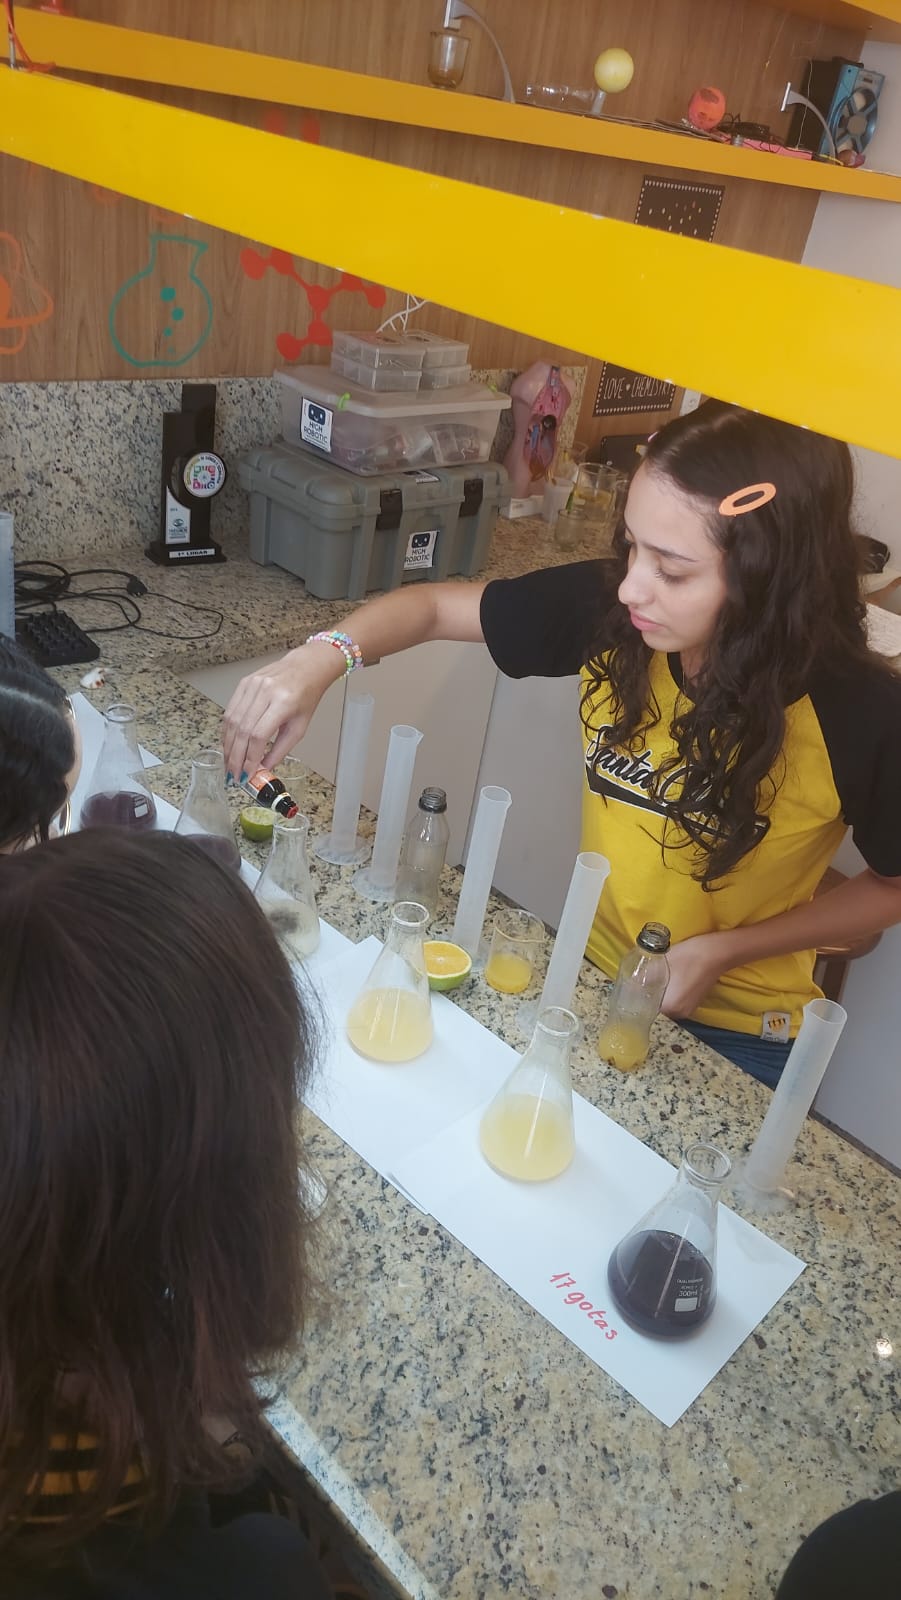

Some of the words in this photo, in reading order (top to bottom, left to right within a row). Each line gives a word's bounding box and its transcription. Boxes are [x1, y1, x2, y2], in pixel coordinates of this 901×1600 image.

[603, 377, 626, 399] LOVE
[303, 425, 328, 443] ROBOTIC
[585, 724, 653, 790] Santa
[549, 1272, 577, 1289] 17
[563, 1292, 618, 1340] gotas
